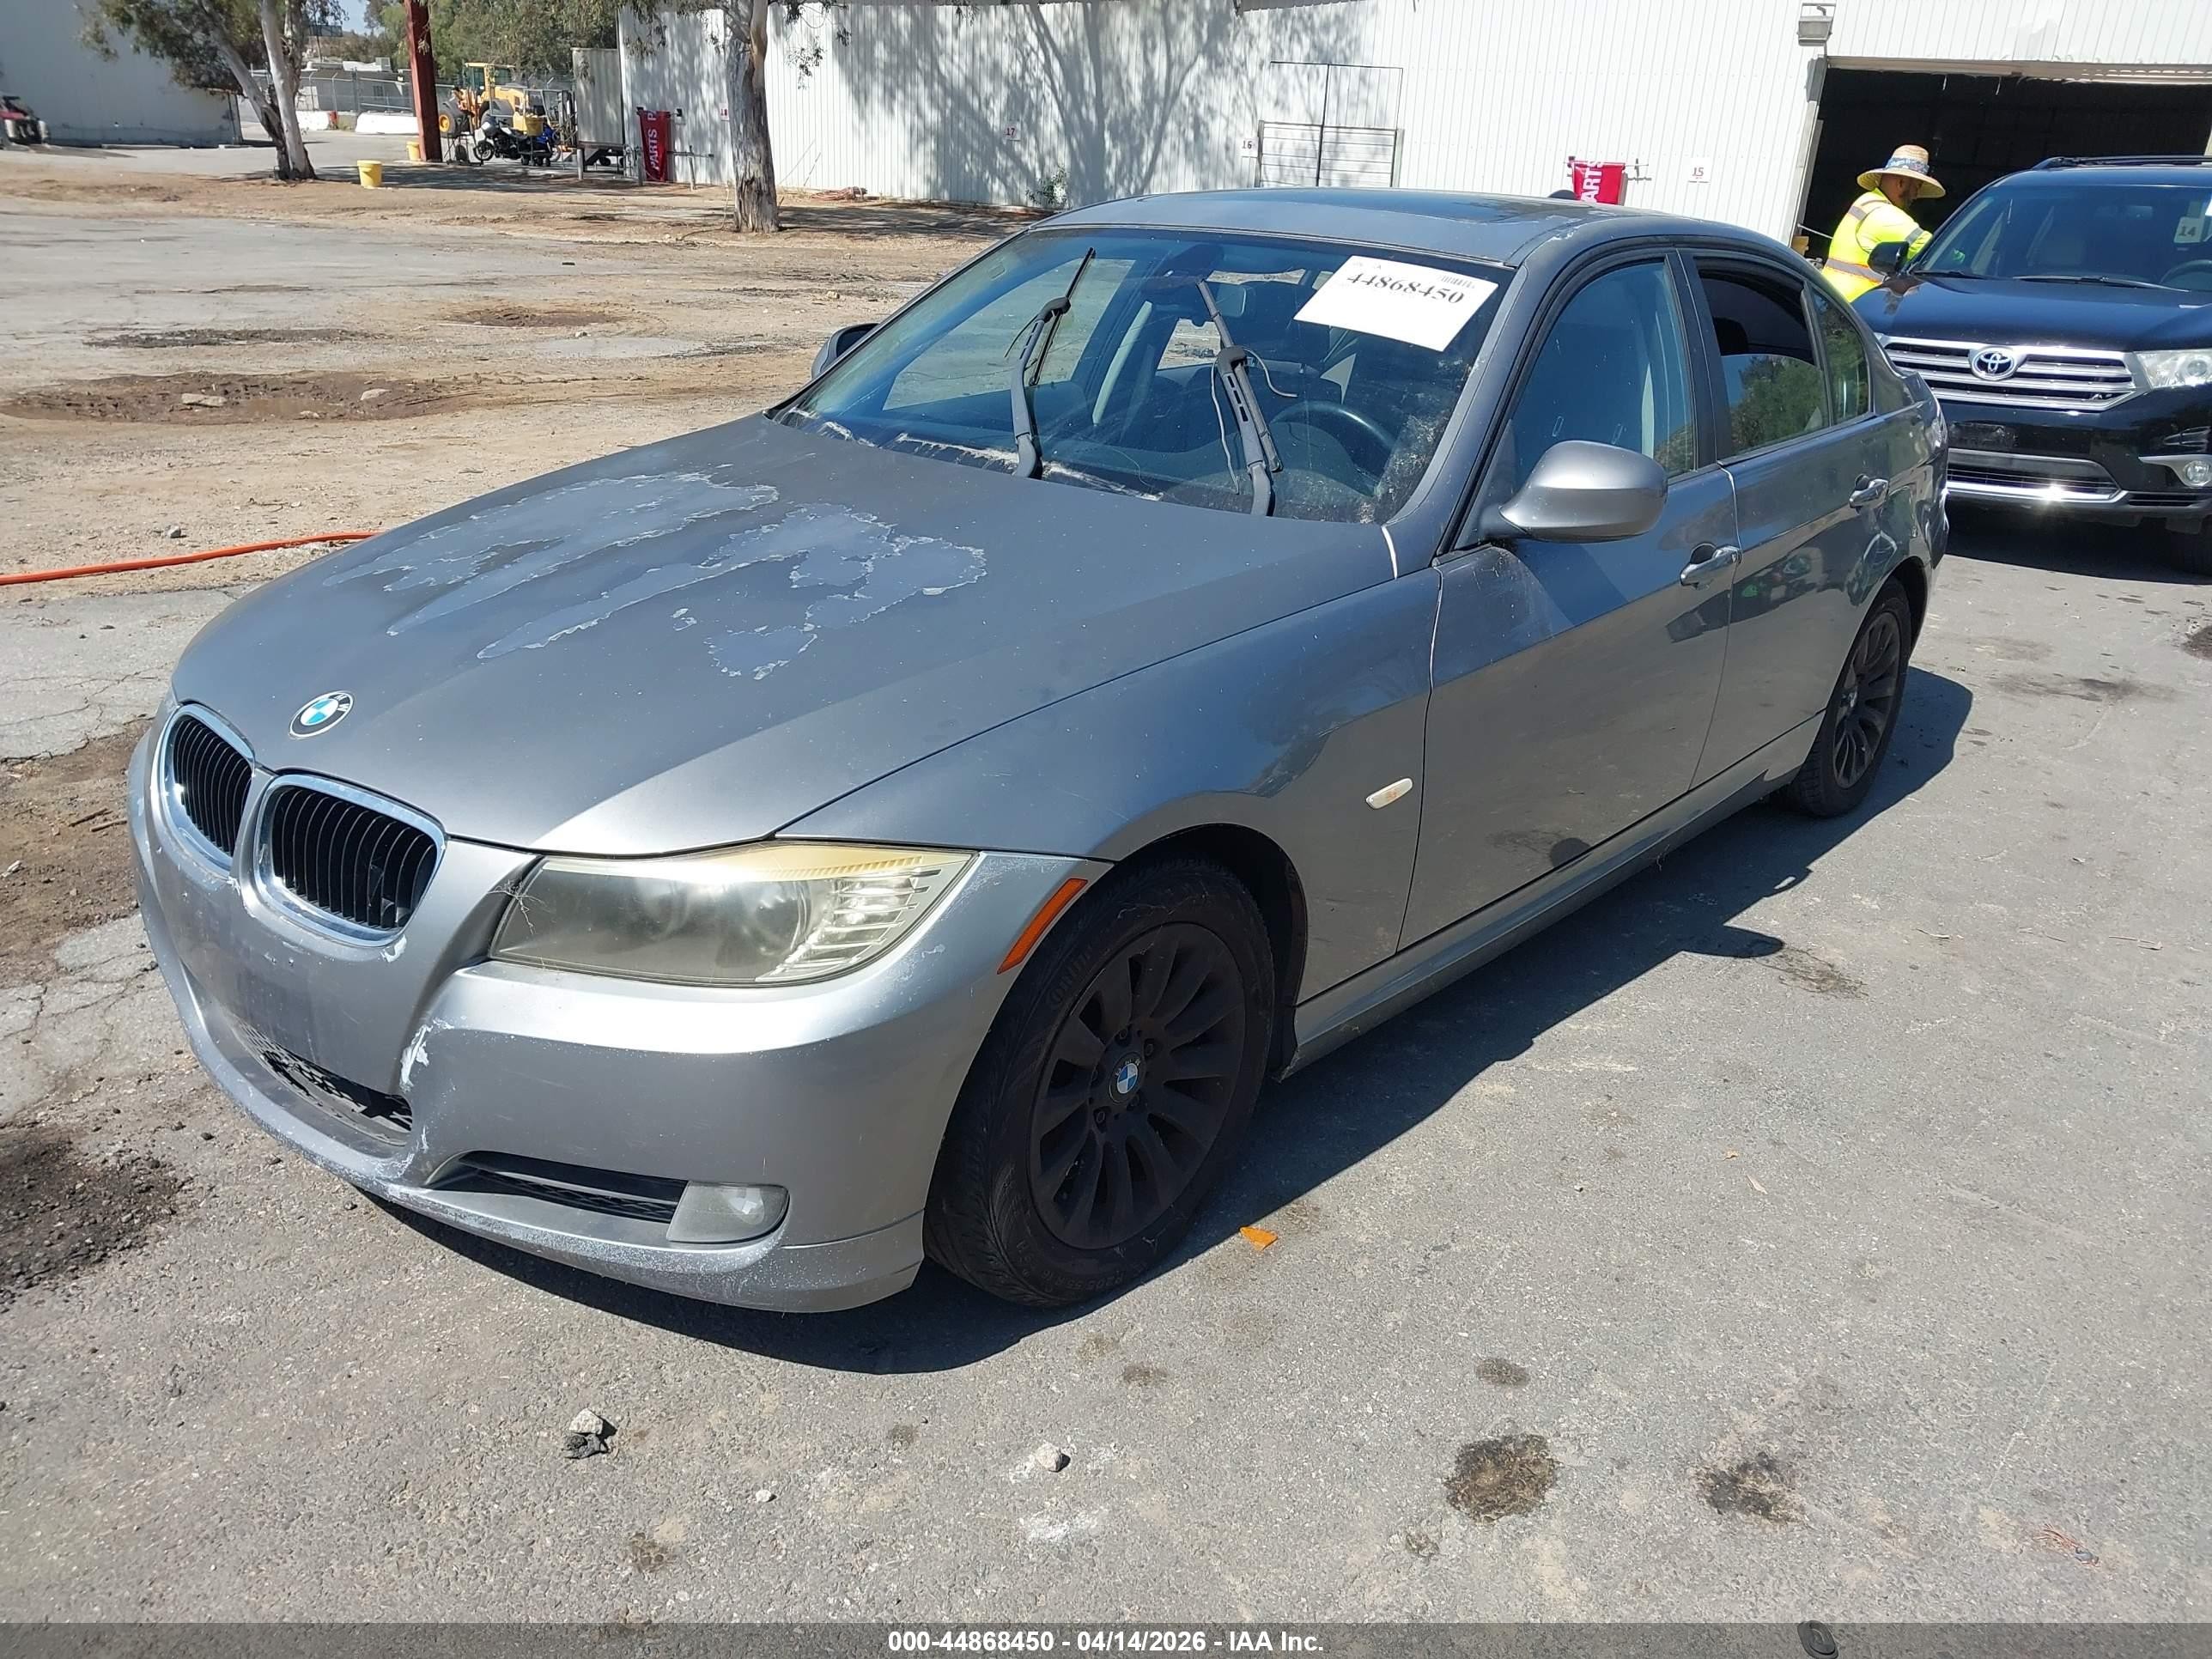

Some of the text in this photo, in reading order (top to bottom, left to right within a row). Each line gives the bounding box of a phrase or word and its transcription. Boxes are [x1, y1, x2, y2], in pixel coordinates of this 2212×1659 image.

[1006, 127, 1016, 137] 17
[647, 110, 660, 171] PARTS P
[1242, 140, 1253, 149] 16
[1692, 167, 1705, 177] 15
[1580, 161, 1604, 203] ARTS
[2177, 226, 2197, 238] 14
[1346, 273, 1465, 304] 44868450
